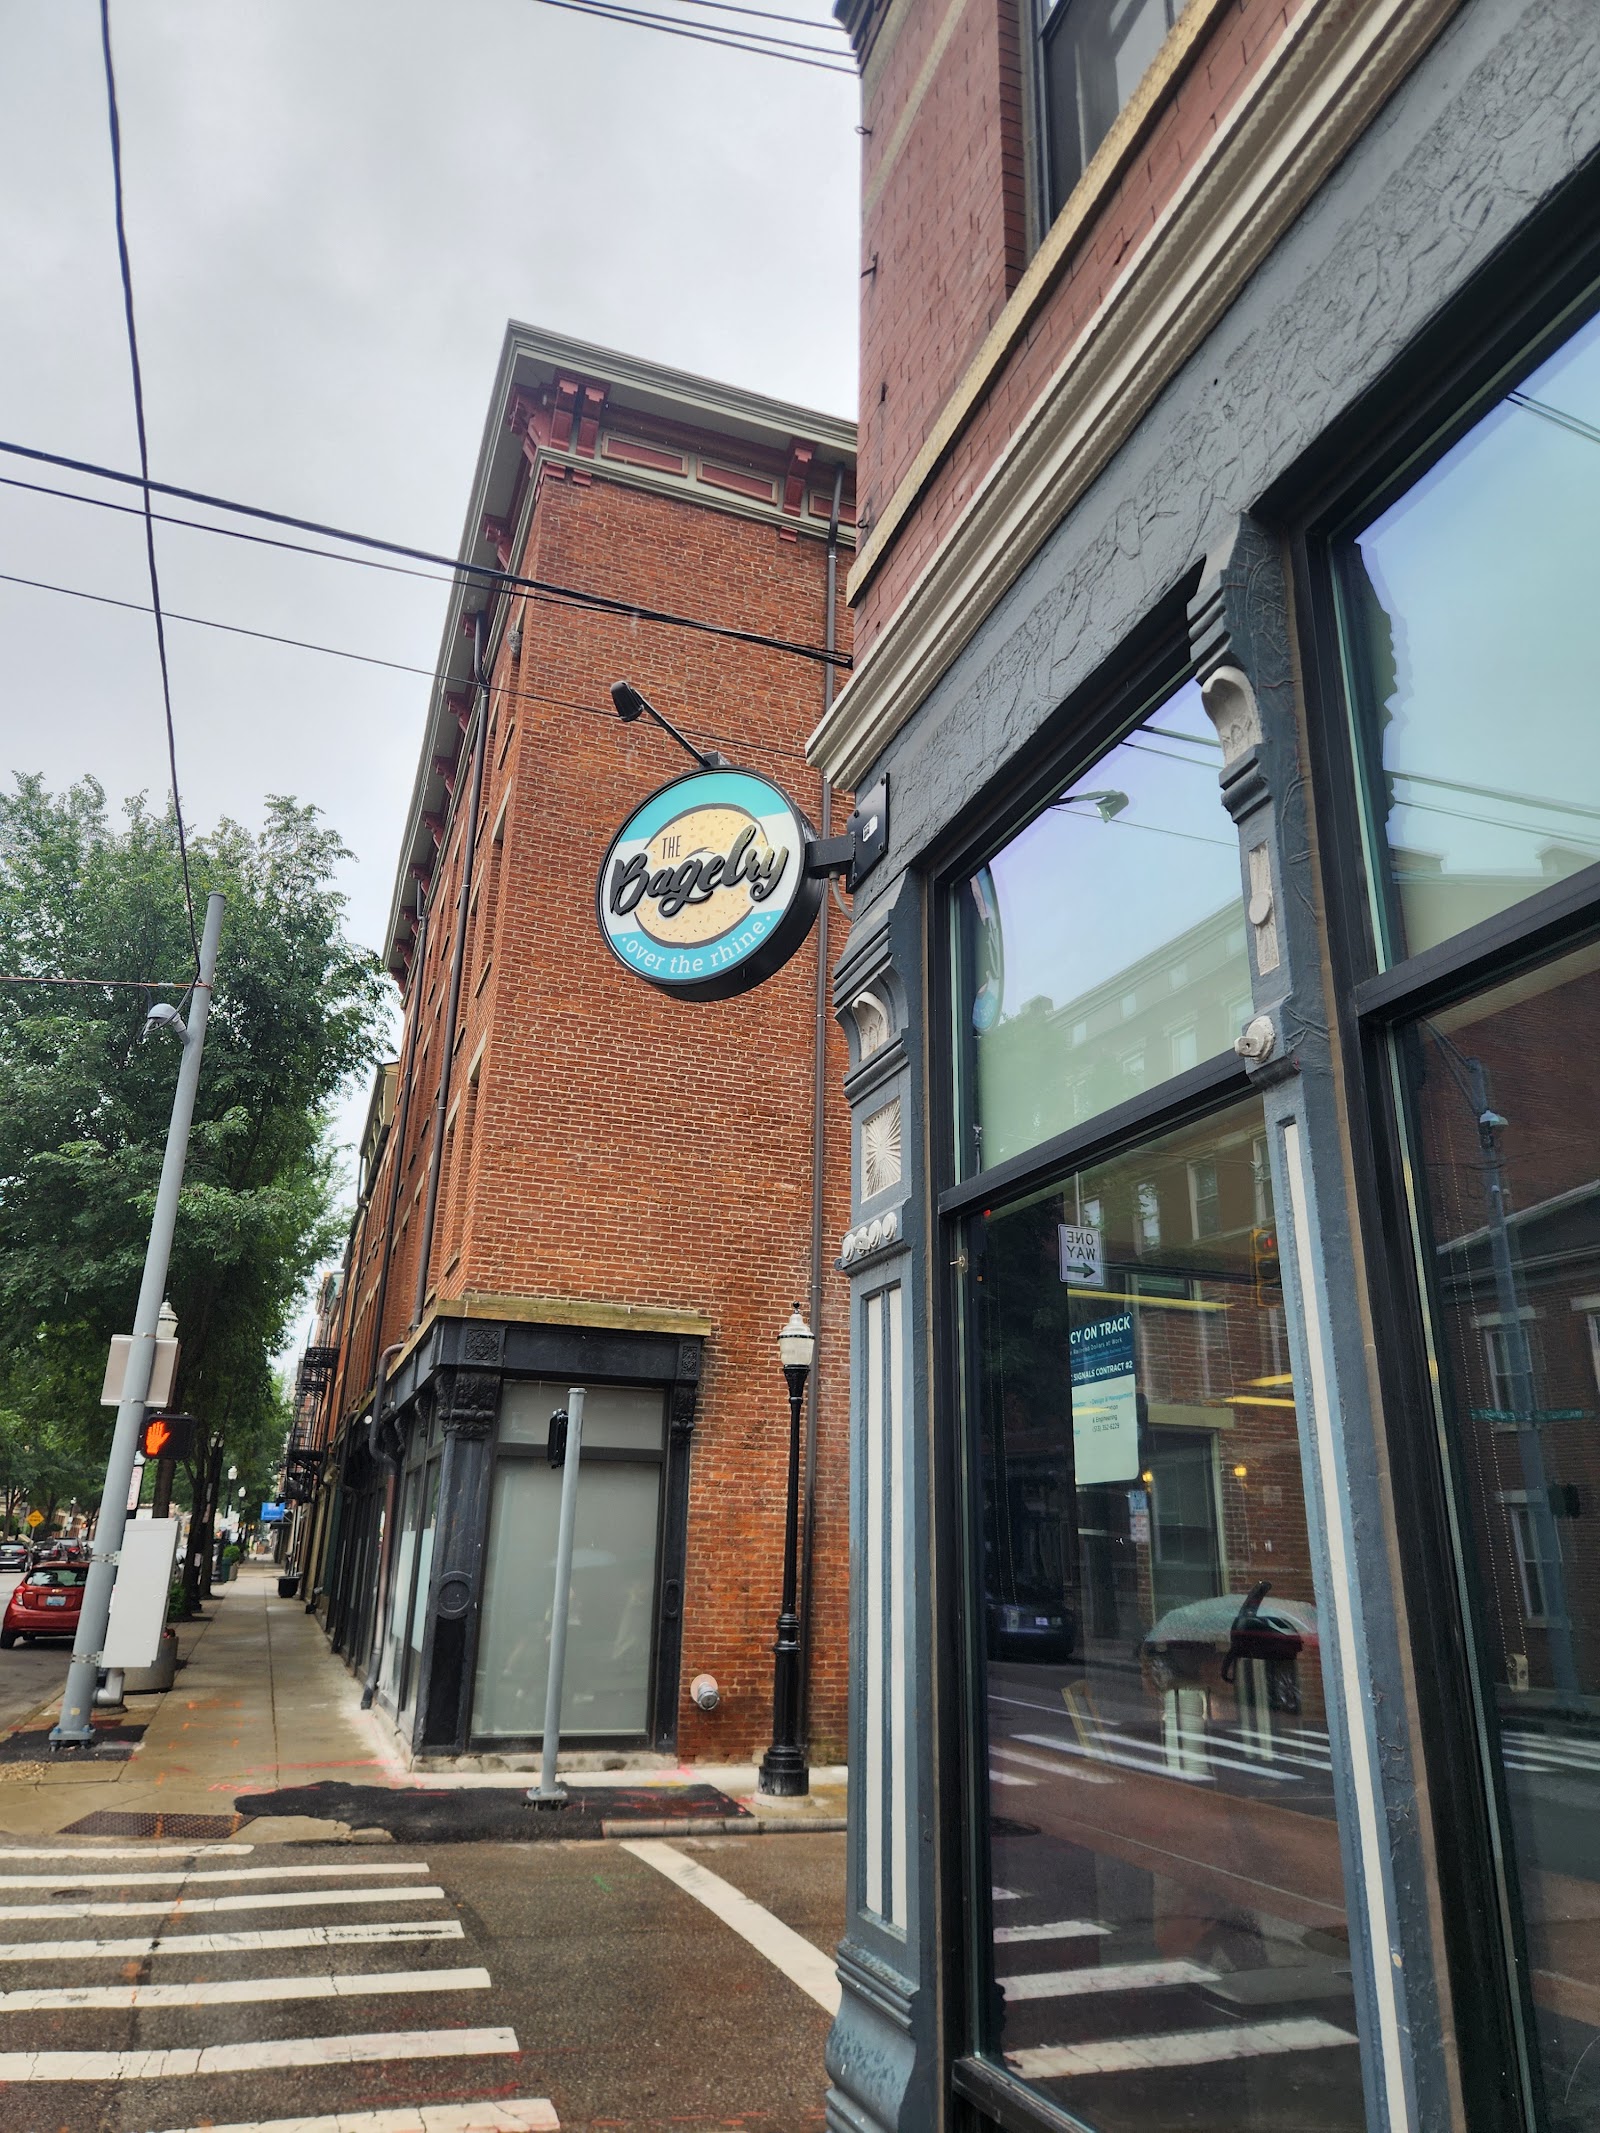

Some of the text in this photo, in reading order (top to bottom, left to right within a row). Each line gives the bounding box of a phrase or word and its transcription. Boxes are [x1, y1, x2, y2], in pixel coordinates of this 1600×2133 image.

[662, 835, 682, 859] THE
[610, 825, 789, 918] Bagelry
[626, 923, 766, 974] over the rhine
[1084, 1326, 1097, 1340] ON
[1100, 1316, 1130, 1336] TRACK
[1073, 1360, 1133, 1381] SIGNALS CONTRACT #2
